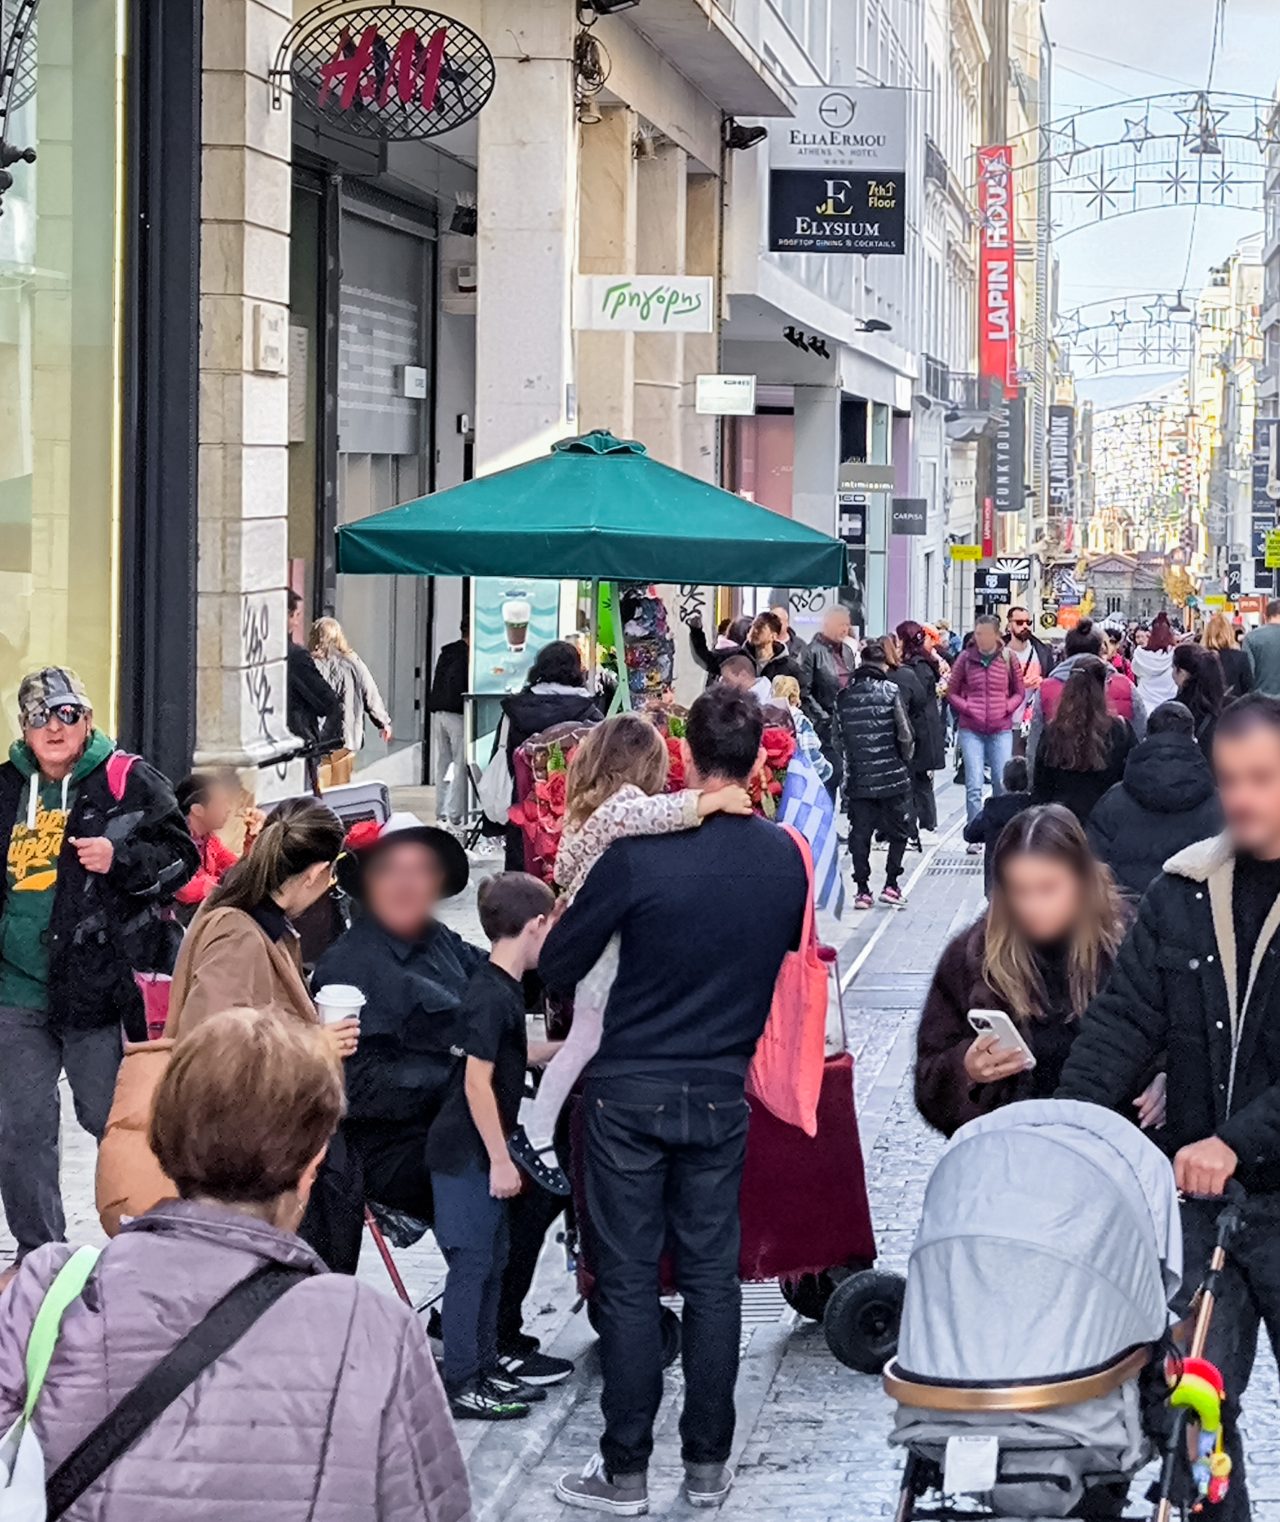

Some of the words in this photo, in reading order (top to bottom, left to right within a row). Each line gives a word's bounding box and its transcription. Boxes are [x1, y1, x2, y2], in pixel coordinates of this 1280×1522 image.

[867, 181, 886, 196] 7th
[868, 197, 896, 208] Floor
[987, 260, 1009, 341] LAPIN
[893, 512, 924, 521] CARPISA
